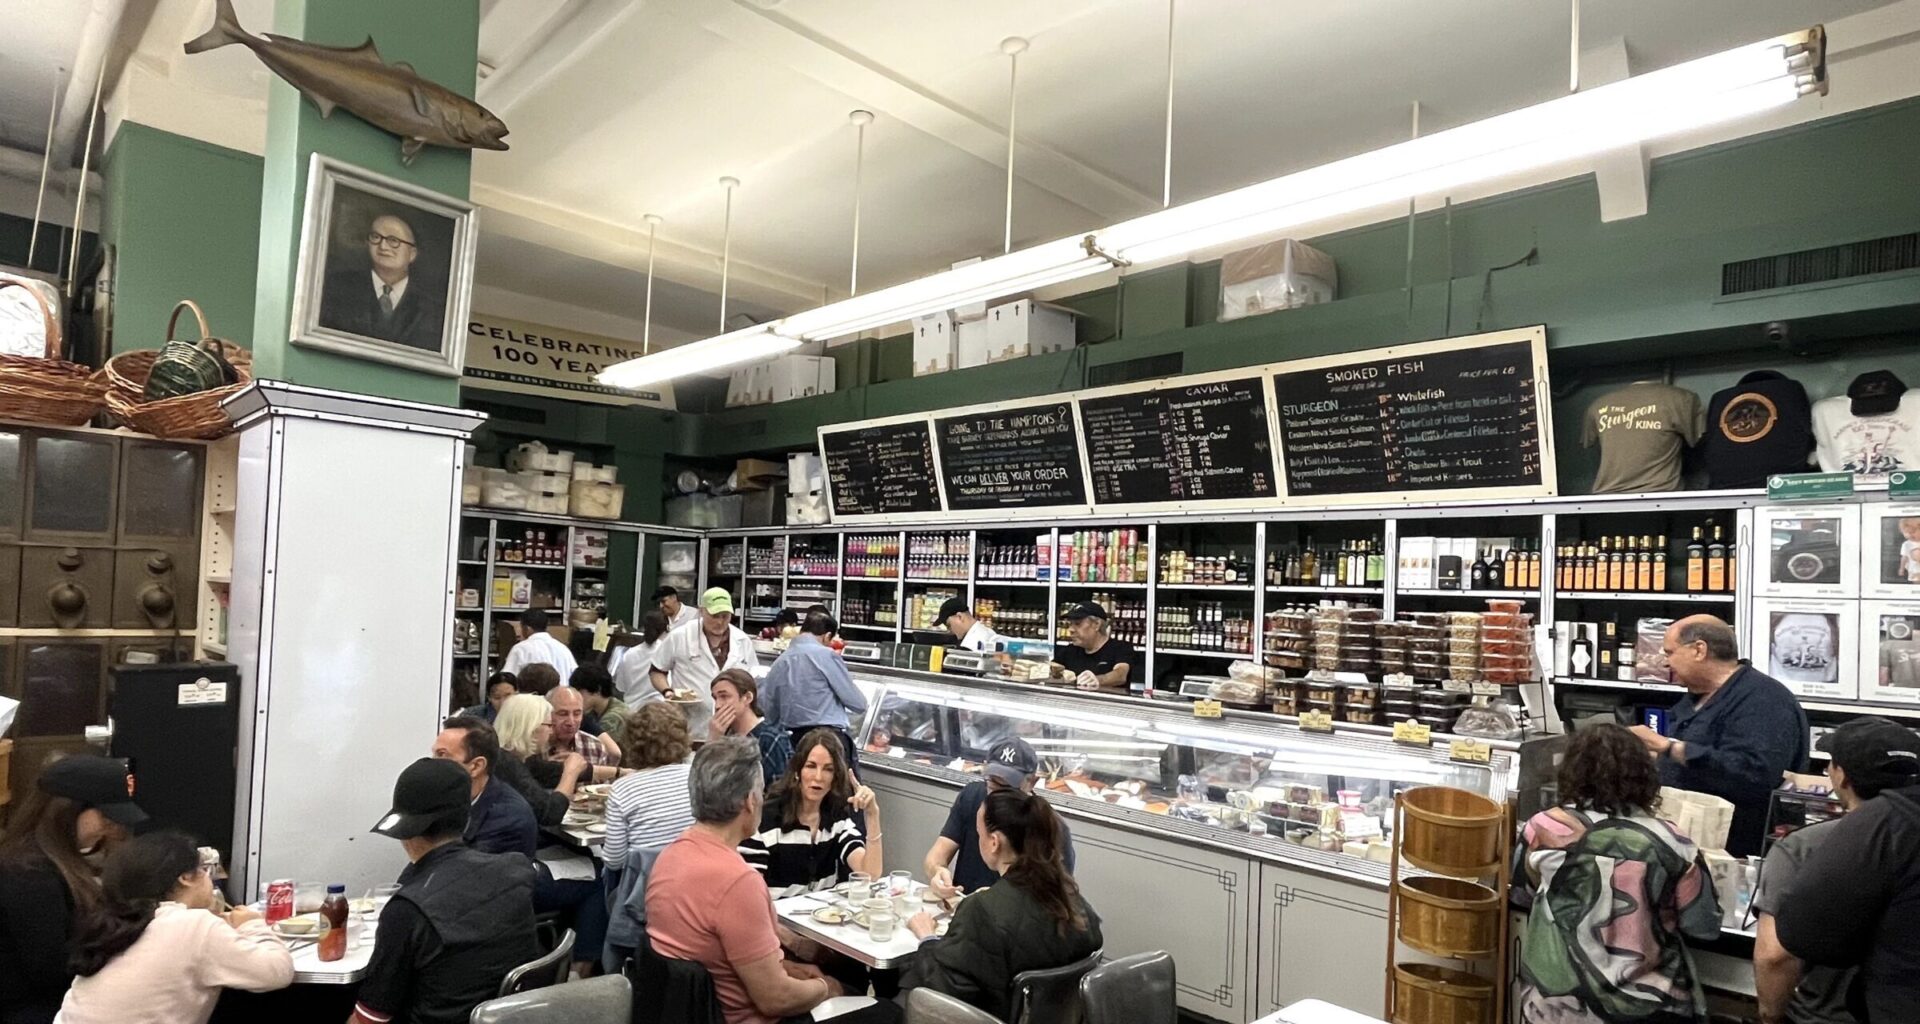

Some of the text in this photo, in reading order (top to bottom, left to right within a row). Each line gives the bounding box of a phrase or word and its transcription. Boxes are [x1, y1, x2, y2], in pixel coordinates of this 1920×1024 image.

[493, 345, 610, 374] 100 YEA
[1326, 361, 1424, 383] SMOKED FISH
[1186, 384, 1228, 396] CAVIAR
[1398, 388, 1445, 401] Whitefish
[1283, 400, 1338, 416] STURGEON
[976, 420, 986, 432] TO
[990, 419, 1004, 430] THE
[1010, 413, 1055, 428] HAMPTONS
[1598, 404, 1656, 432] Sturgeon
[1635, 420, 1662, 430] KING
[952, 467, 1068, 485] WE CAN DELIVER YOUR ORDER
[1036, 483, 1053, 491] CITY
[1000, 747, 1016, 762] NY
